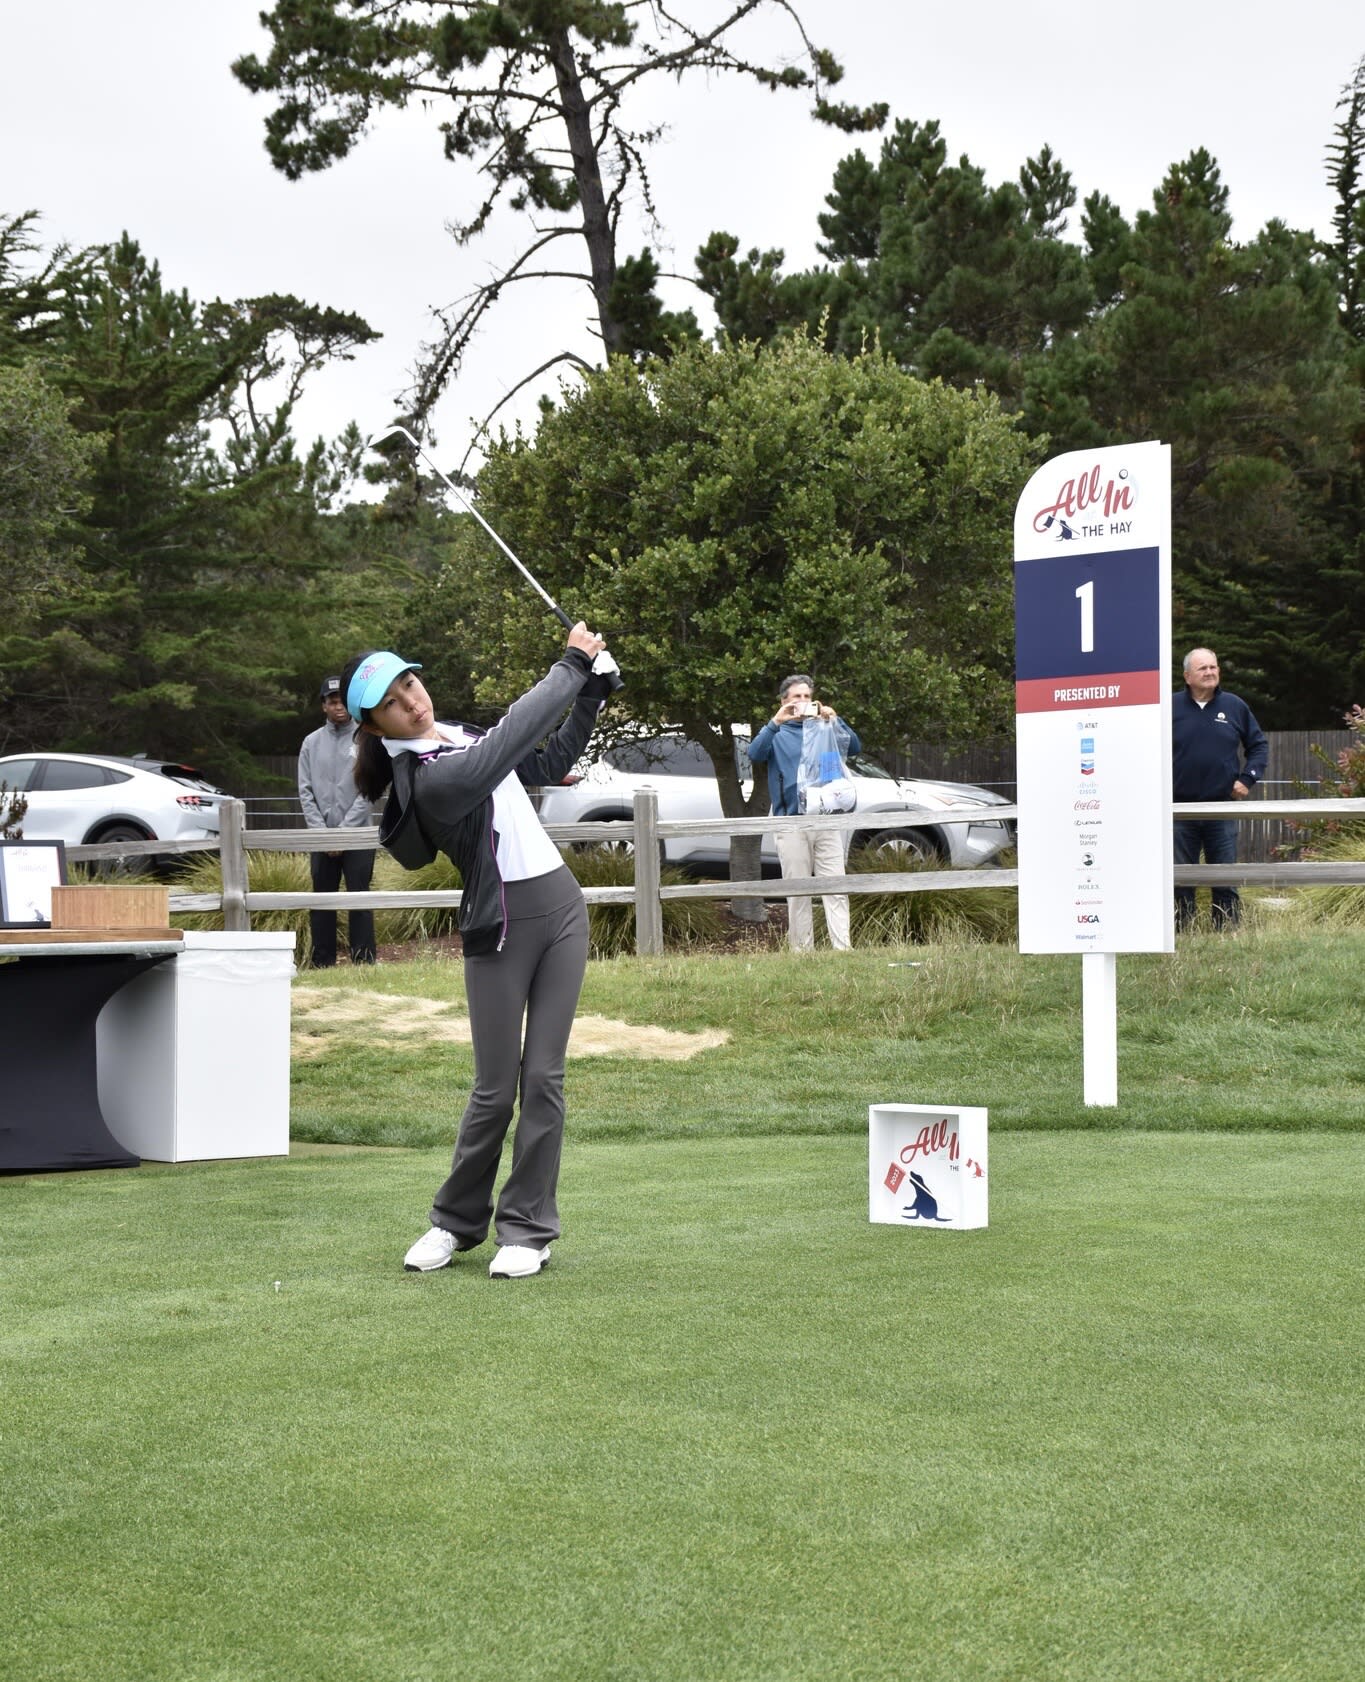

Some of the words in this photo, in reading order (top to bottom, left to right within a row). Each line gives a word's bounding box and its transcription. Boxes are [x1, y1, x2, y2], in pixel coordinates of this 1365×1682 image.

[1033, 464, 1102, 533] All
[1103, 479, 1134, 518] In
[1082, 524, 1104, 538] THE
[1110, 520, 1133, 536] HAY
[1075, 580, 1094, 653] 1
[1054, 686, 1106, 703] PRESENTED
[1107, 685, 1121, 699] BY
[1079, 833, 1097, 841] Morgan
[1077, 915, 1100, 923] USGA
[900, 1118, 949, 1164] All
